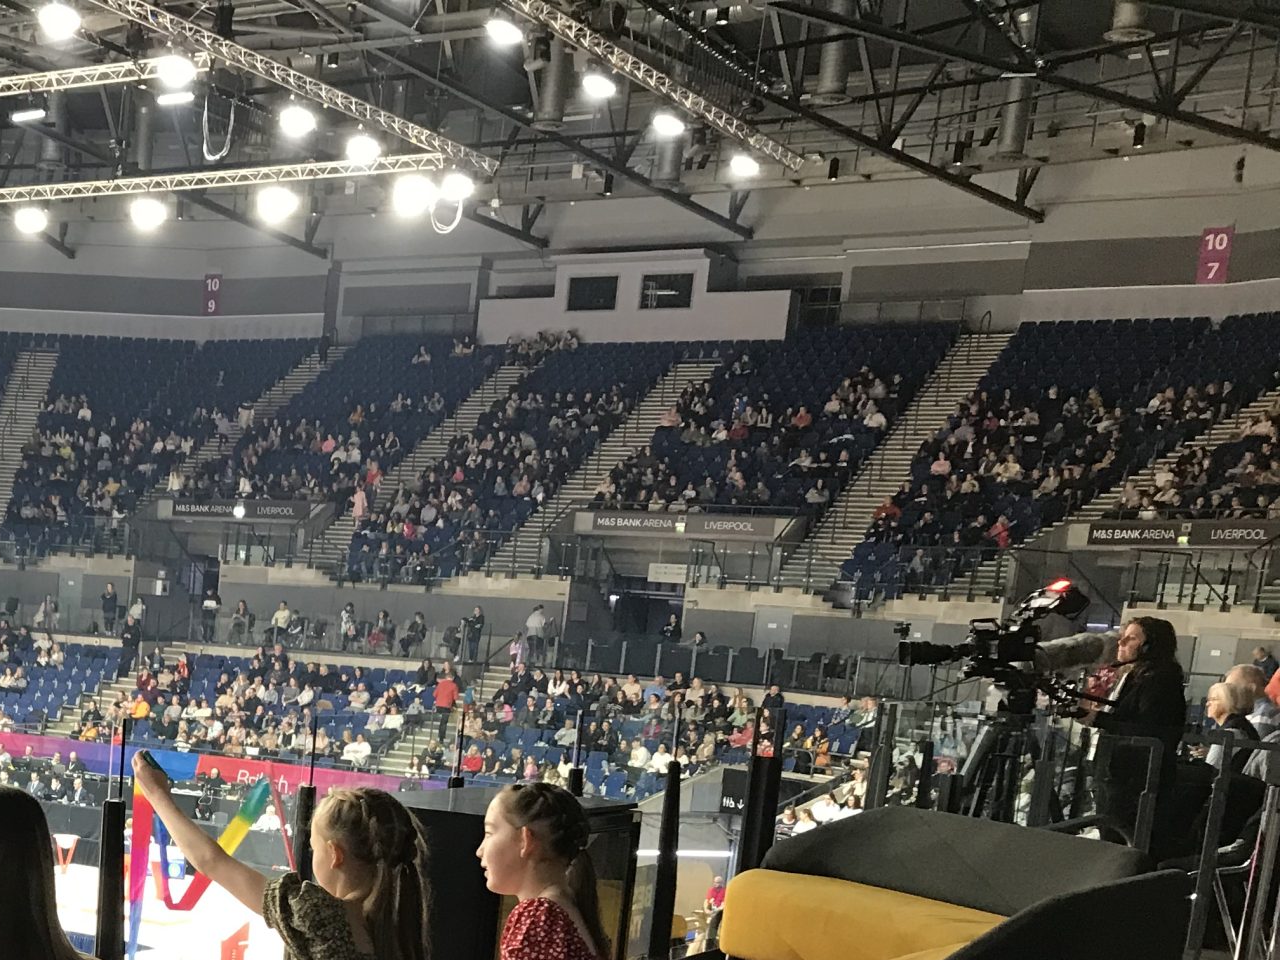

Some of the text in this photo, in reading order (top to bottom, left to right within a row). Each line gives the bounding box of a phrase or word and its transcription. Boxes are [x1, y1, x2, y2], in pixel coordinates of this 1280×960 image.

[1205, 233, 1228, 250] 10
[1207, 262, 1220, 280] 7
[206, 278, 220, 291] 10
[207, 299, 216, 313] 9
[175, 503, 295, 517] M&S BANK ARENA LIVERPOOL
[597, 517, 755, 532] M&S BANK ARENA LIVERPOOL
[1092, 528, 1269, 541] M&S BANK ARENA LIVERPOOL
